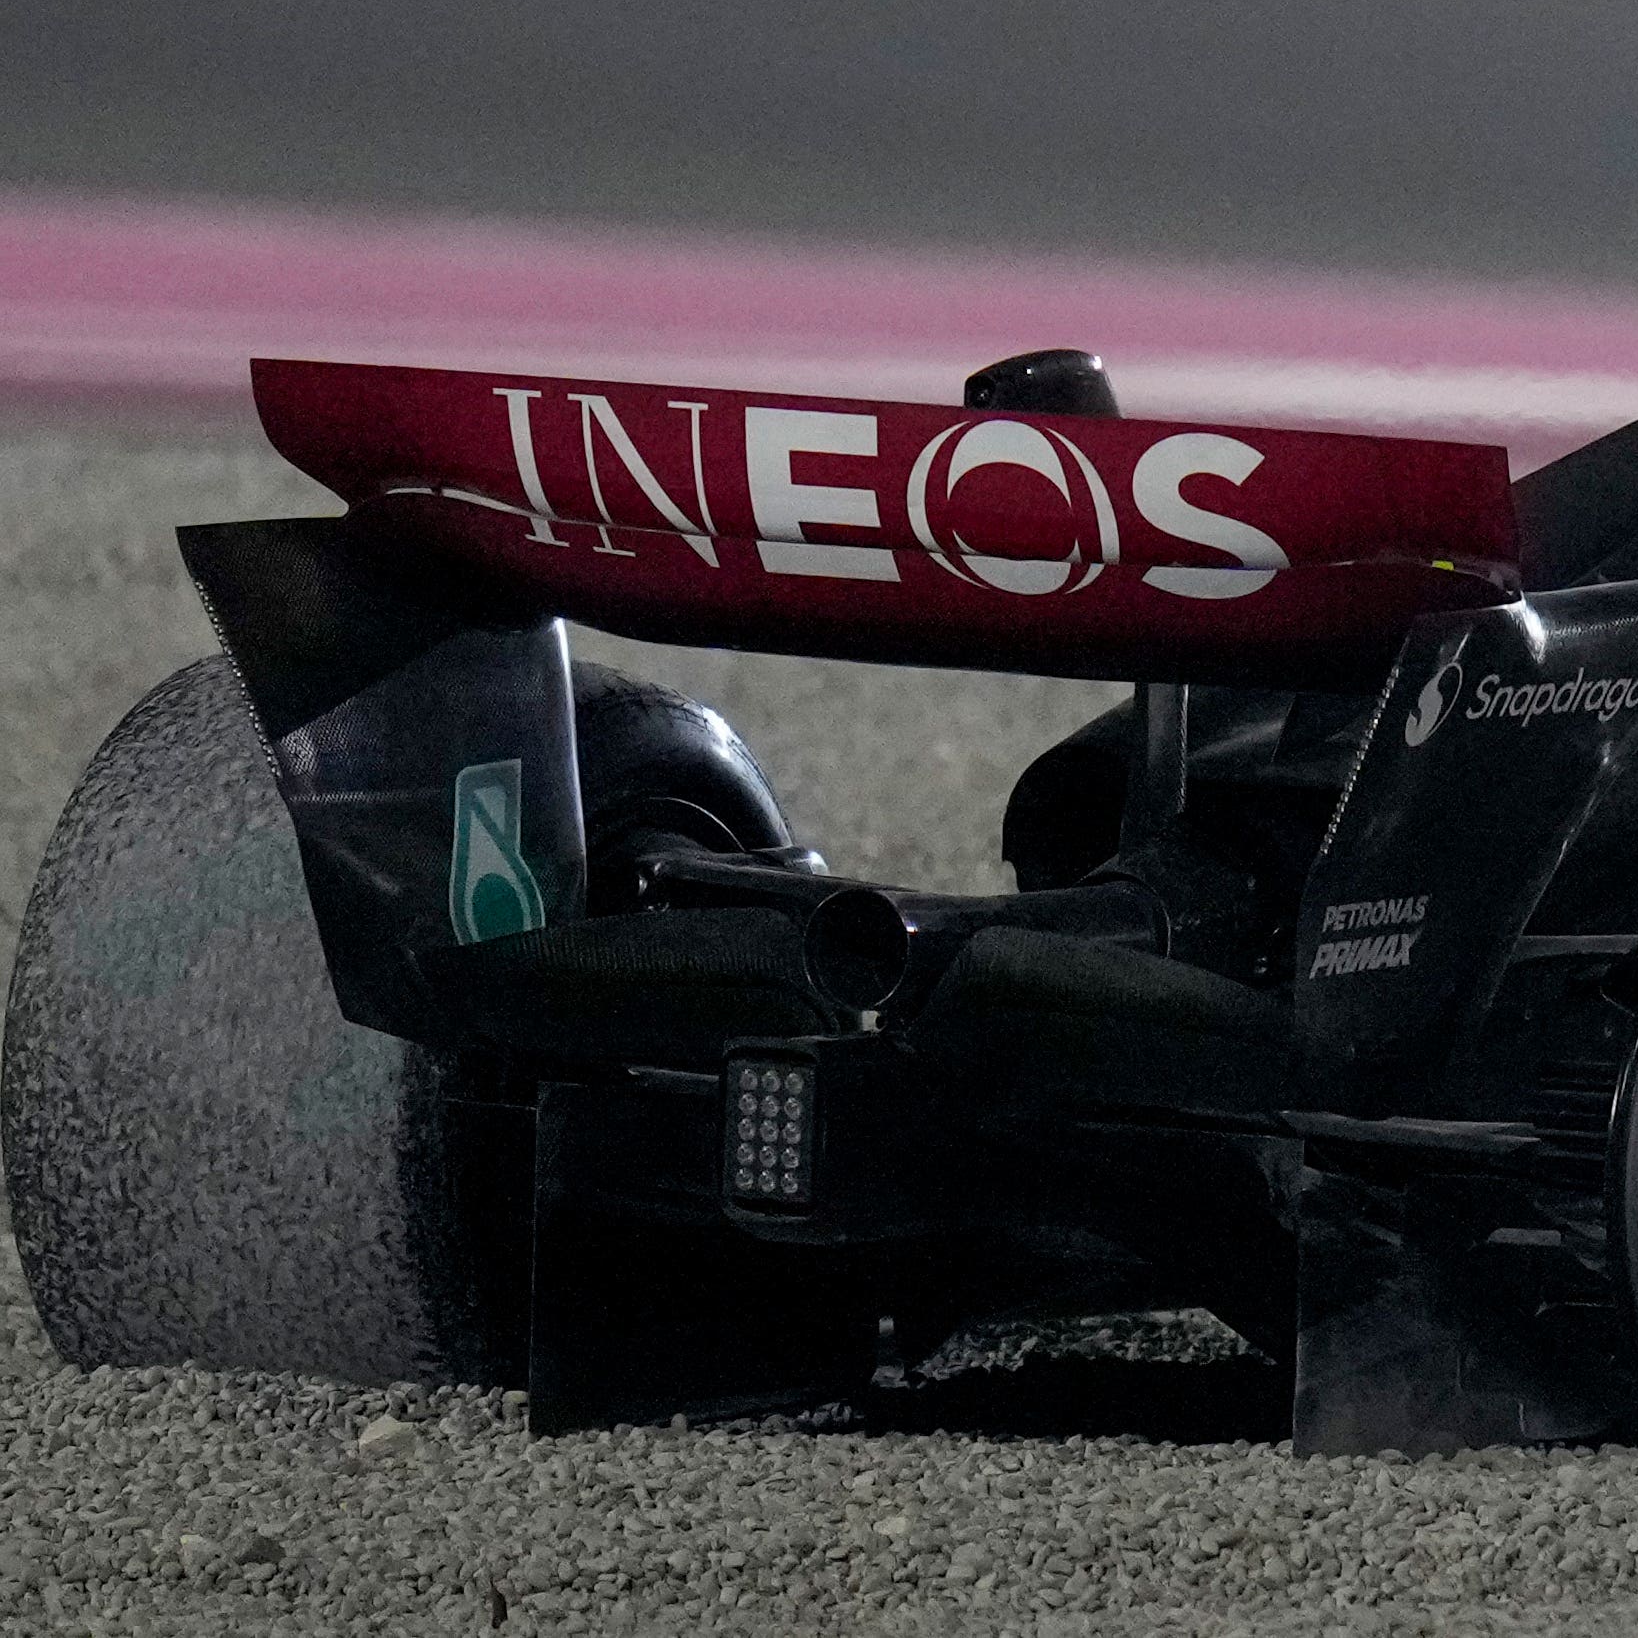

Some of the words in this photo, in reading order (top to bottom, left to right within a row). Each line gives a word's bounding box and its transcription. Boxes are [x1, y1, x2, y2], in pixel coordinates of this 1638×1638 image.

[492, 386, 1292, 600] INEOS
[1321, 894, 1431, 934] PETRONAS
[1308, 928, 1424, 980] PRIMAX
